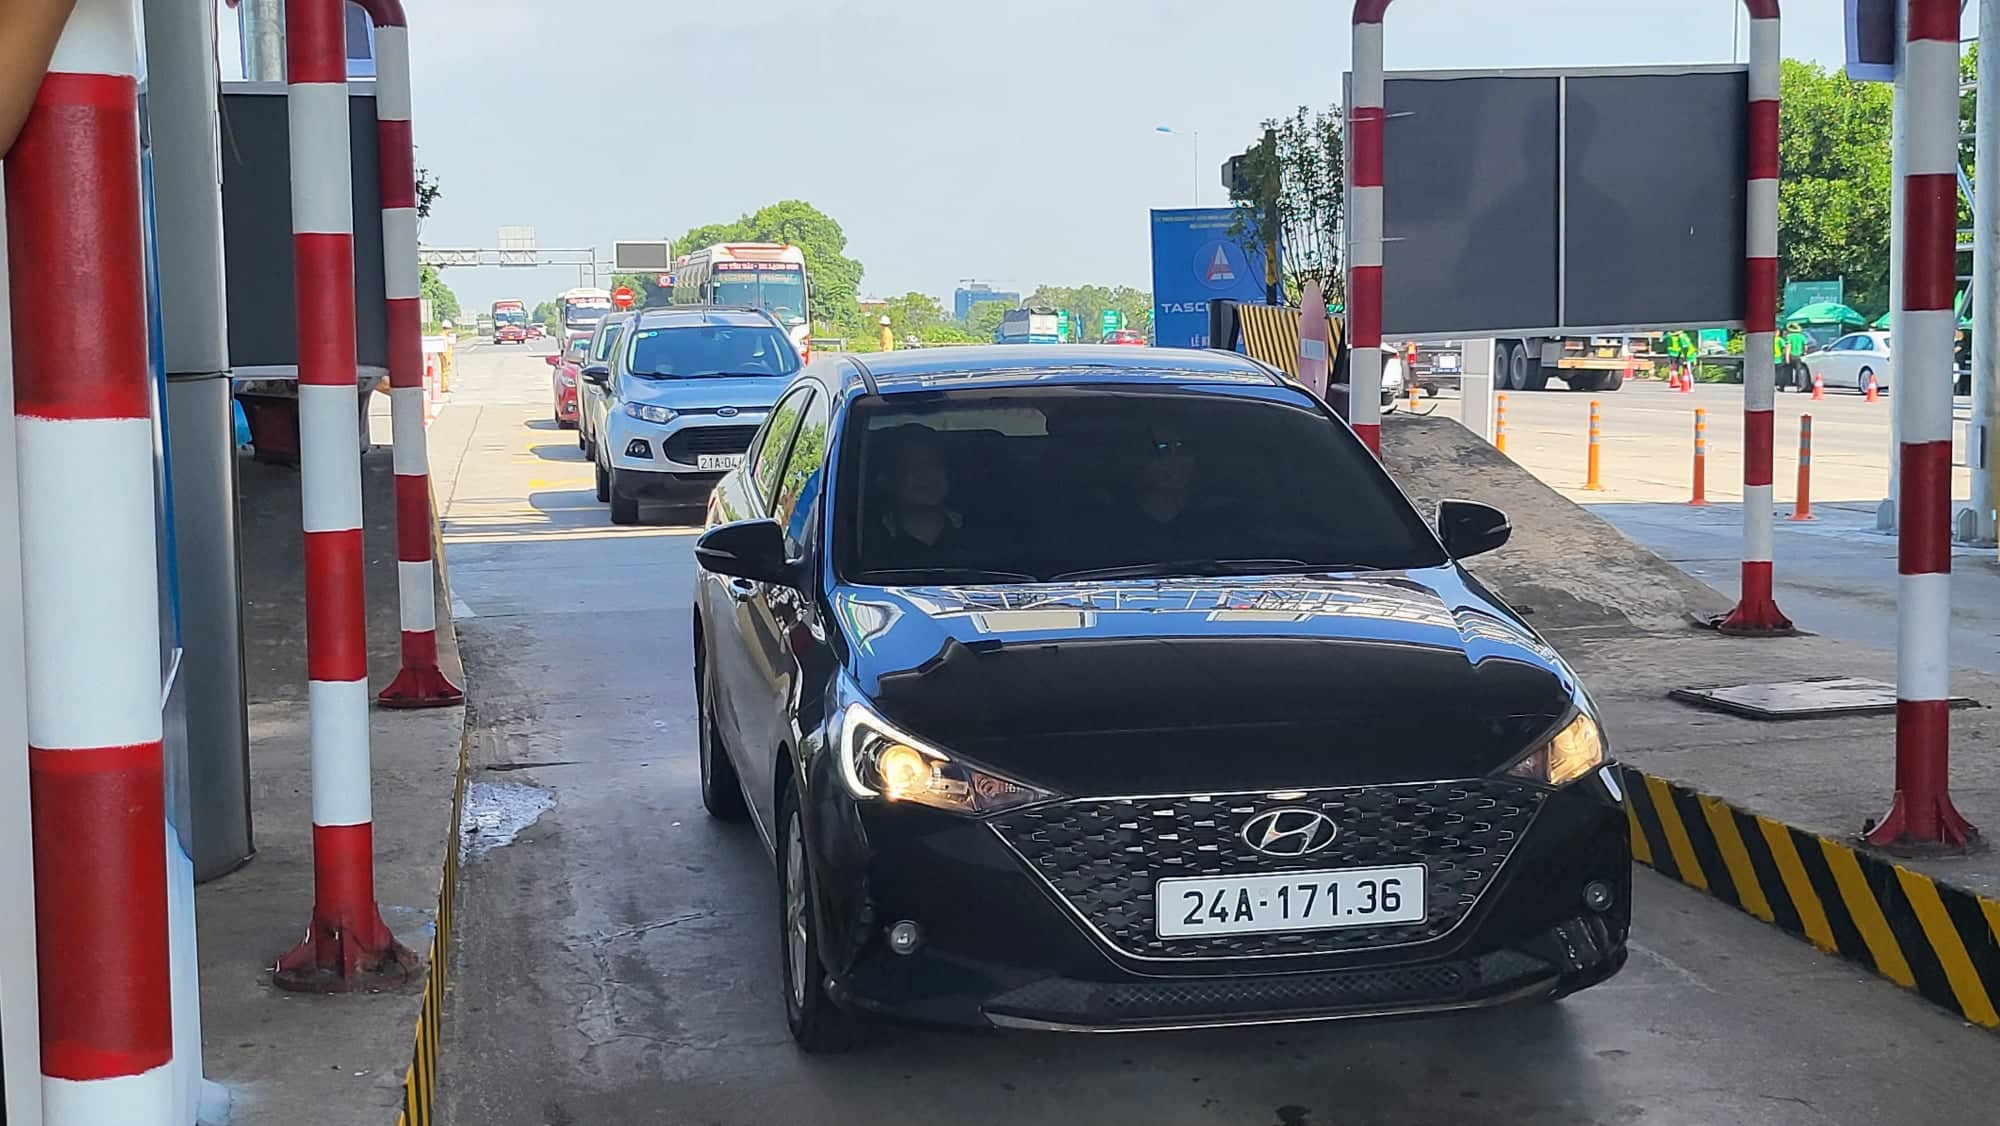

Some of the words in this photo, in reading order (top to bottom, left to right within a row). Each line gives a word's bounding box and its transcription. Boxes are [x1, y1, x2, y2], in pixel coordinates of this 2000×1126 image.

[1161, 302, 1209, 314] TASC
[700, 456, 743, 469] 21A-04
[1183, 879, 1401, 925] 24A-171.36
